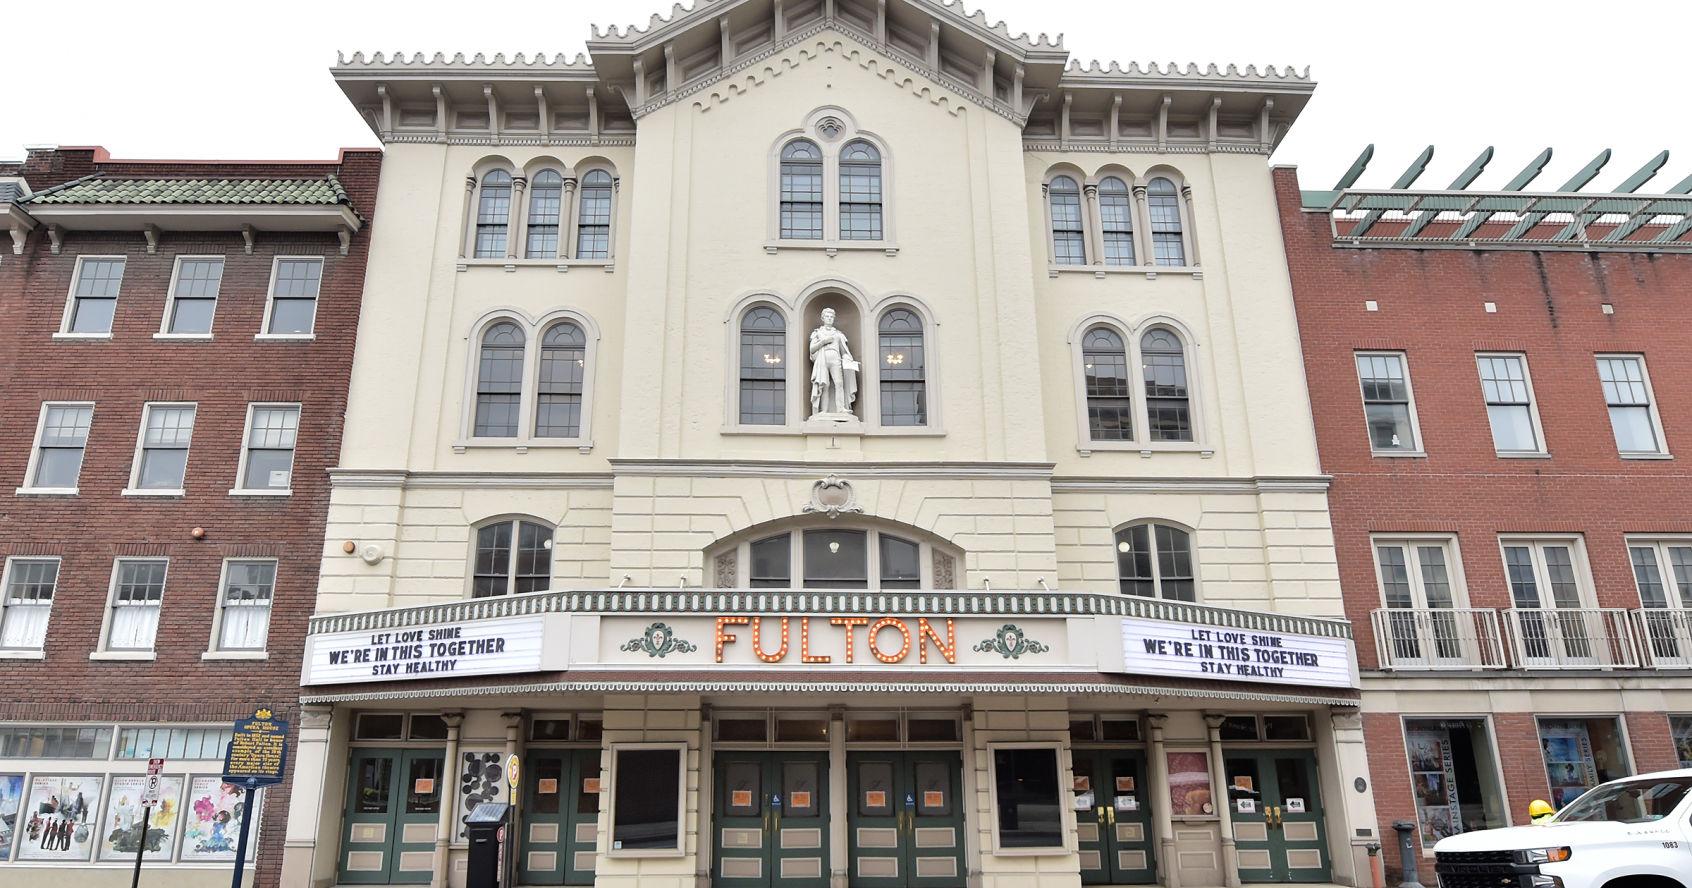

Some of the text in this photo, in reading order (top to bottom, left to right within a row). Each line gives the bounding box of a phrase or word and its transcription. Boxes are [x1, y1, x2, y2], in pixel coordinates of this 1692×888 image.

[372, 627, 461, 645] LET LOVE SHINE
[716, 617, 956, 663] FULTON
[1192, 629, 1282, 647] LET LOVE SHINE
[330, 638, 505, 664] WE'RE IN THIS TOGETHER
[1144, 639, 1319, 666] WE'RE IN THIS TOGETHER
[372, 660, 457, 675] STAY HEALTHY
[1201, 662, 1283, 677] STAY HEALTHY
[1440, 739, 1452, 774] SERIES
[1586, 764, 1596, 788] AMILY
